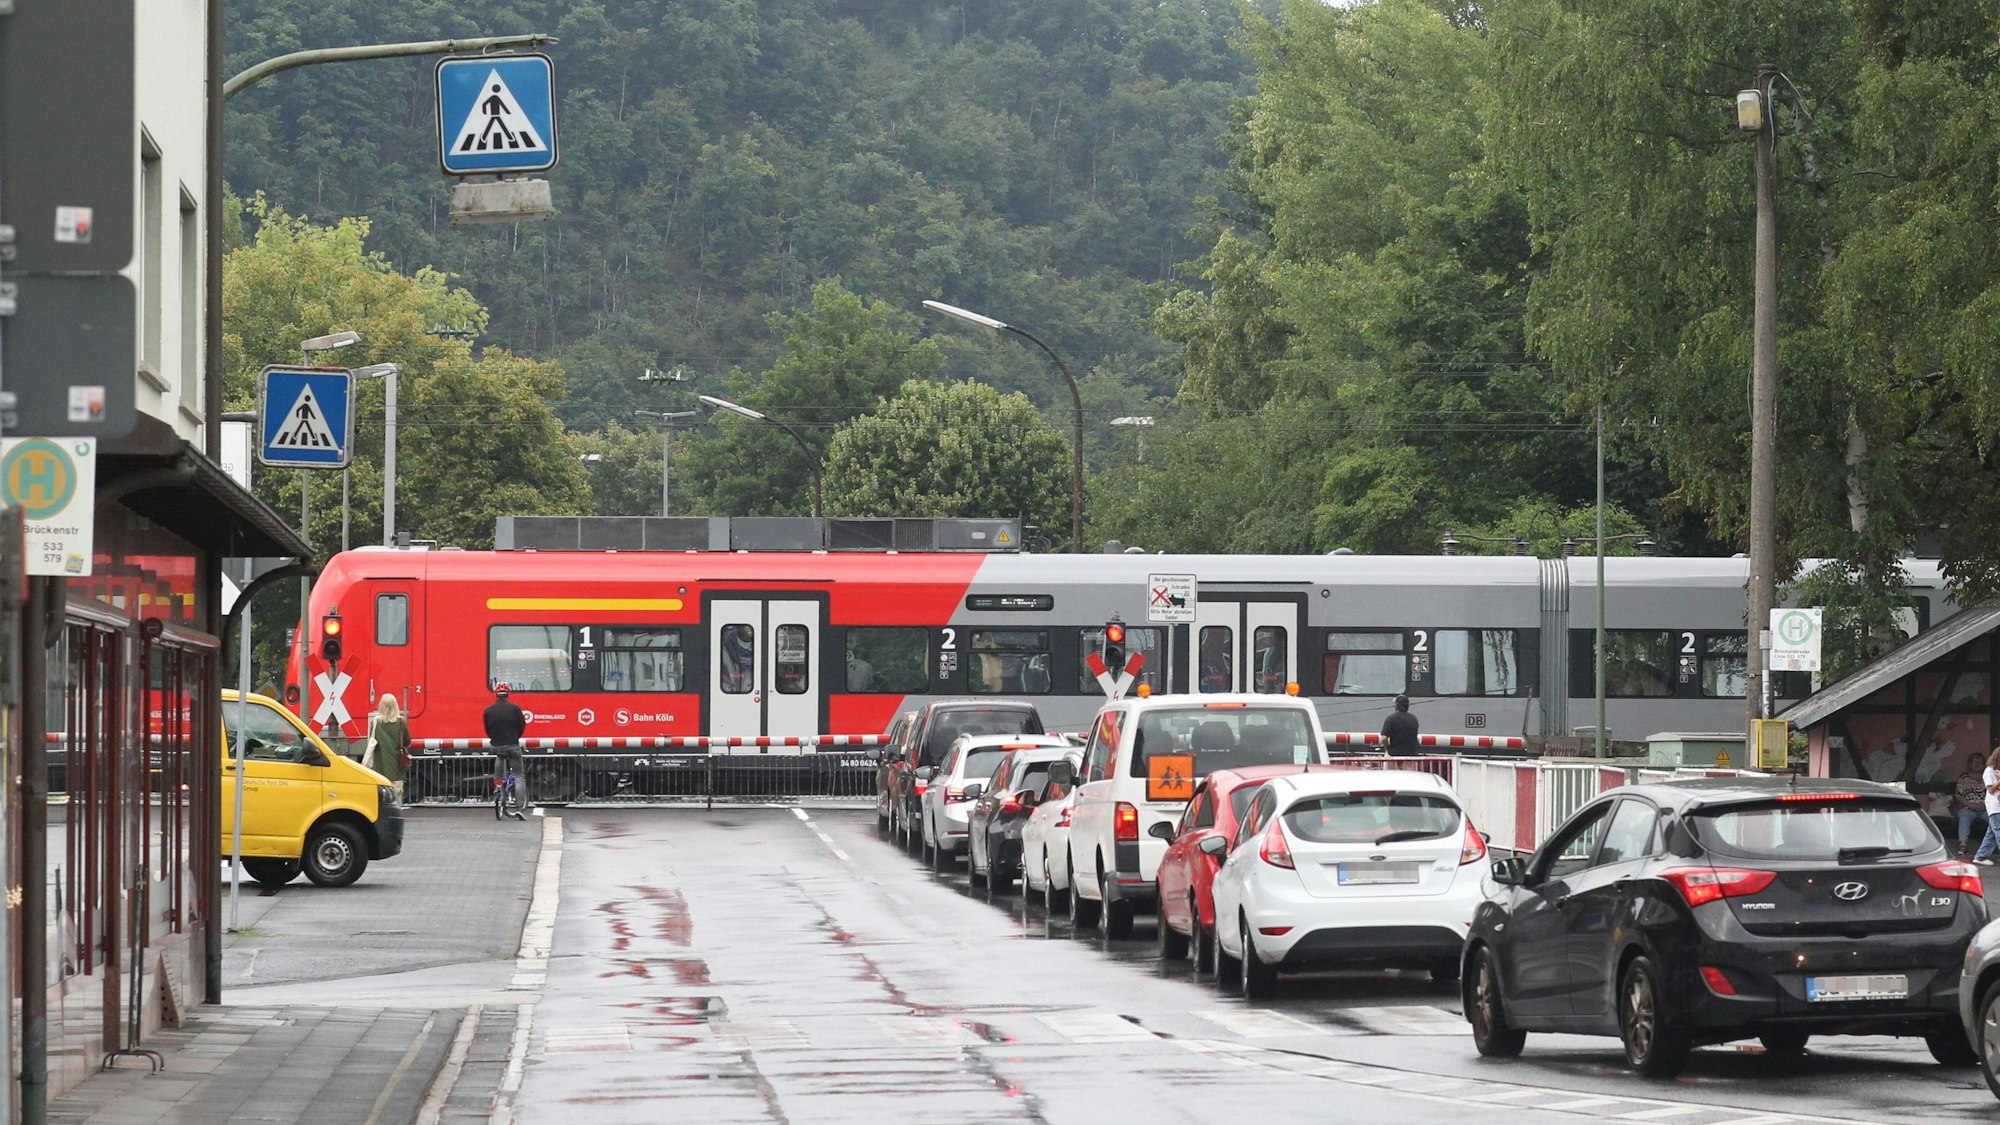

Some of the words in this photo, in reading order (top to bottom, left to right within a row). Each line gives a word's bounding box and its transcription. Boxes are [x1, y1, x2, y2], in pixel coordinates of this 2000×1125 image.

[43, 542, 63, 552] 533
[44, 554, 62, 563] 579
[579, 626, 594, 648] 1
[941, 627, 956, 650] 2
[1413, 630, 1428, 652] 2
[1681, 632, 1696, 653] 2
[415, 685, 422, 693] 2
[616, 710, 629, 725] S
[633, 713, 654, 722] Bahn
[655, 713, 674, 722] Köln
[1467, 716, 1484, 726] DB
[1931, 897, 1951, 906] i30
